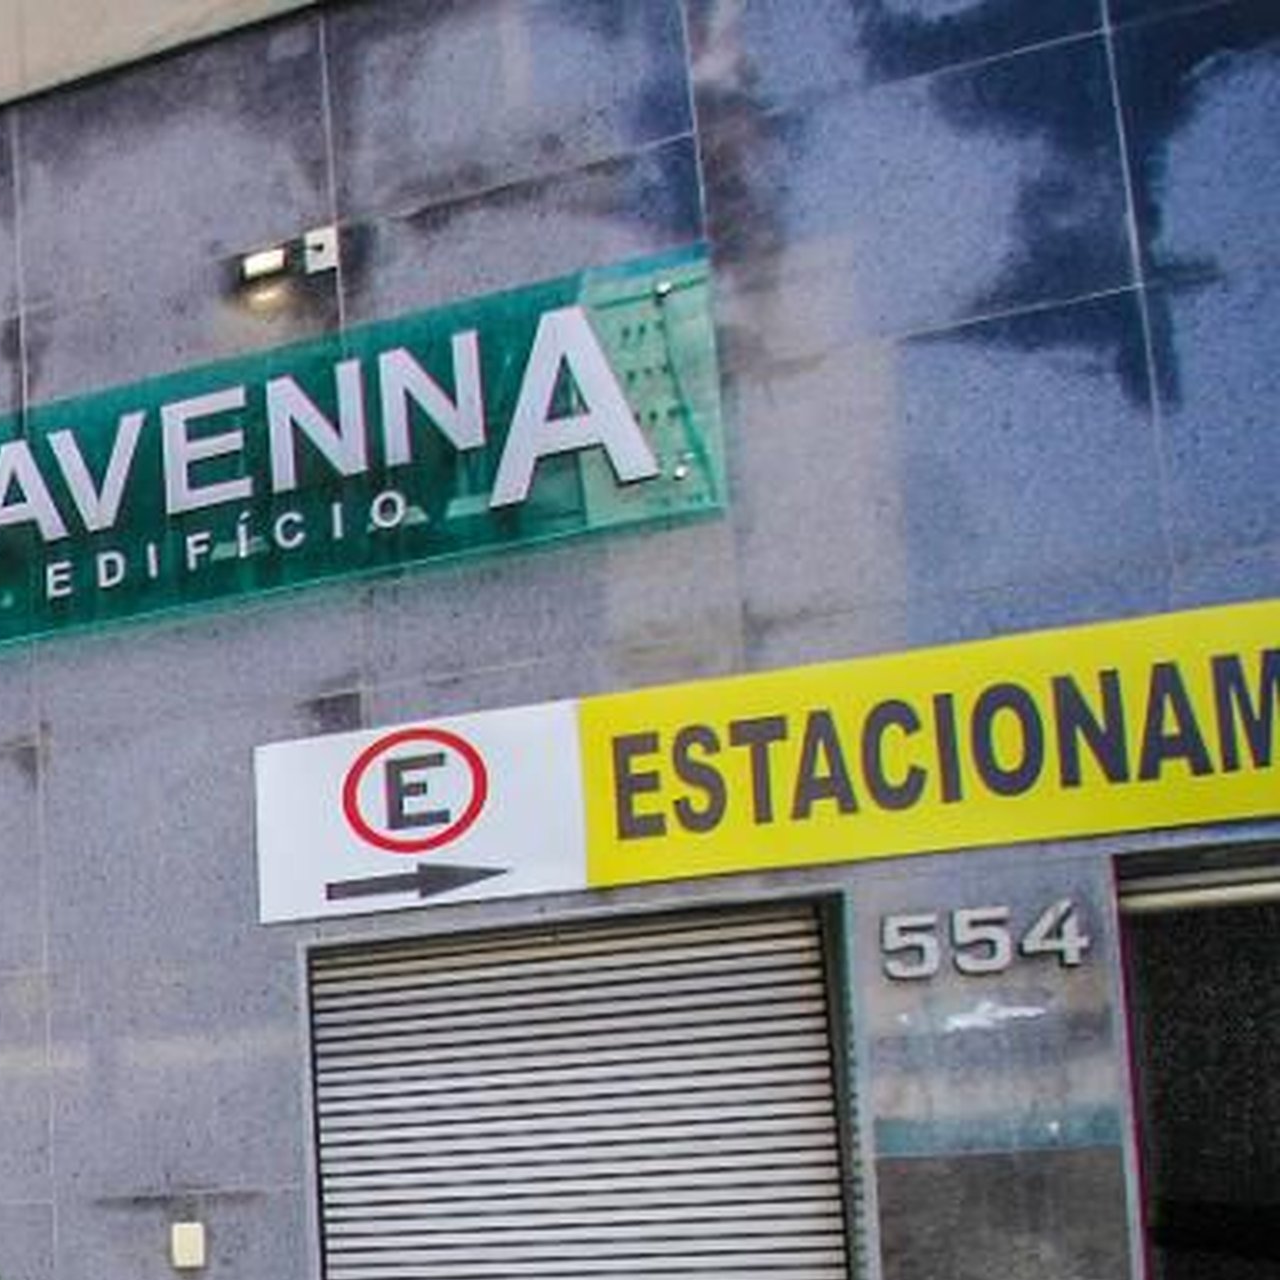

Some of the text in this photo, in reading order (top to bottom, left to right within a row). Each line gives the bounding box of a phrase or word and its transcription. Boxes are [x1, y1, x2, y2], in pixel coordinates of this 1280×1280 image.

[46, 489, 408, 598] EDIFÍCIO
[384, 752, 451, 831] E
[611, 649, 1280, 842] ESTACIONAM
[881, 900, 1089, 980] 554
